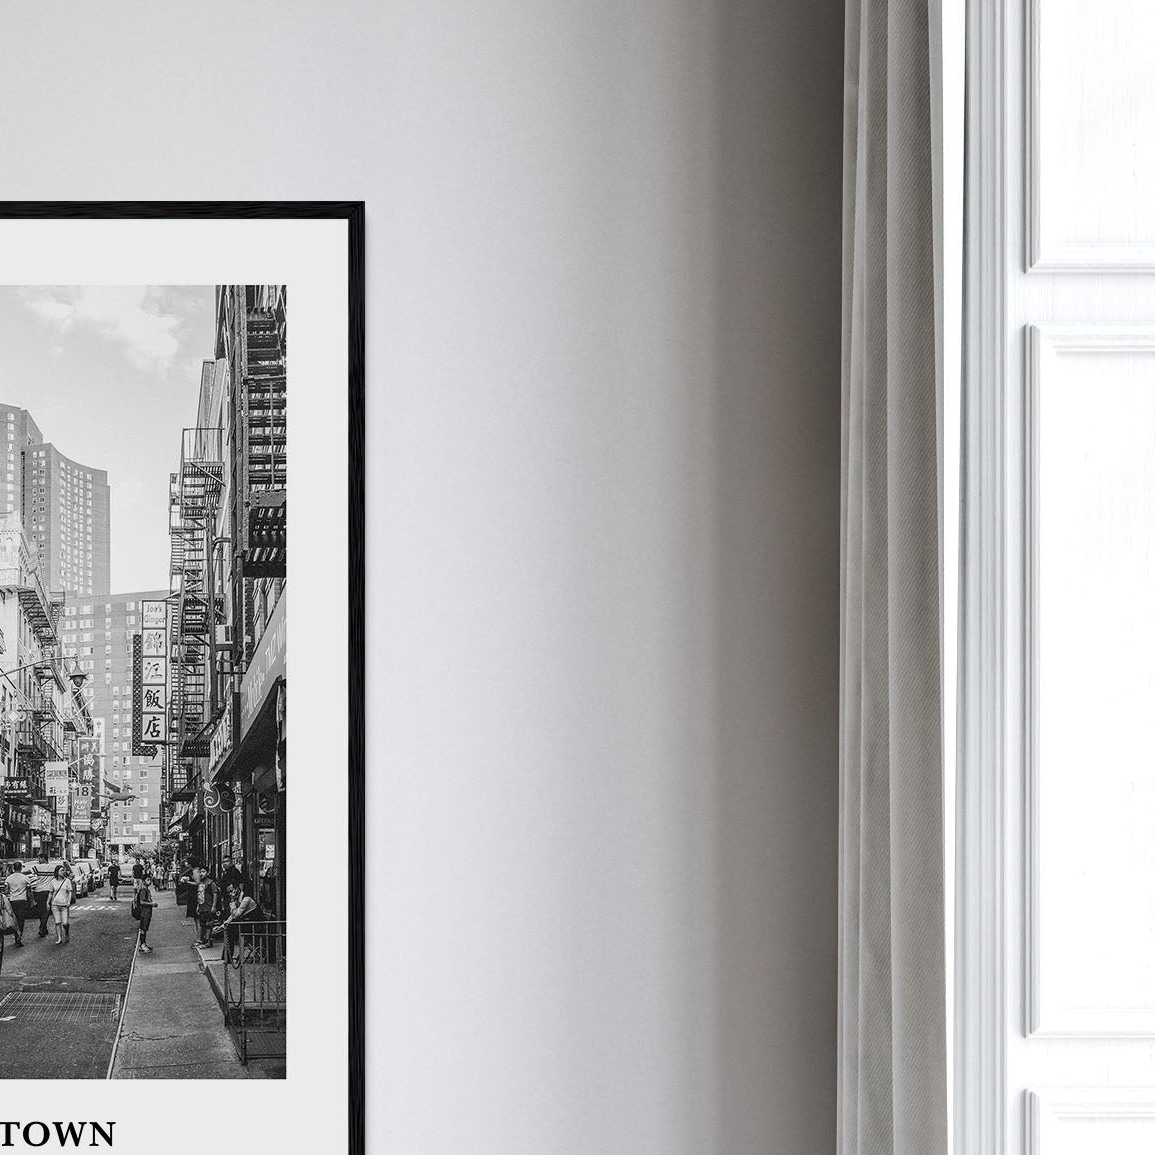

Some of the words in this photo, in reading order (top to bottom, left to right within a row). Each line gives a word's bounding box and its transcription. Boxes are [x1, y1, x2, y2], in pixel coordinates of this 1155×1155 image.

[147, 604, 163, 613] Joe's
[145, 615, 166, 625] Ginger
[75, 786, 89, 797] 18
